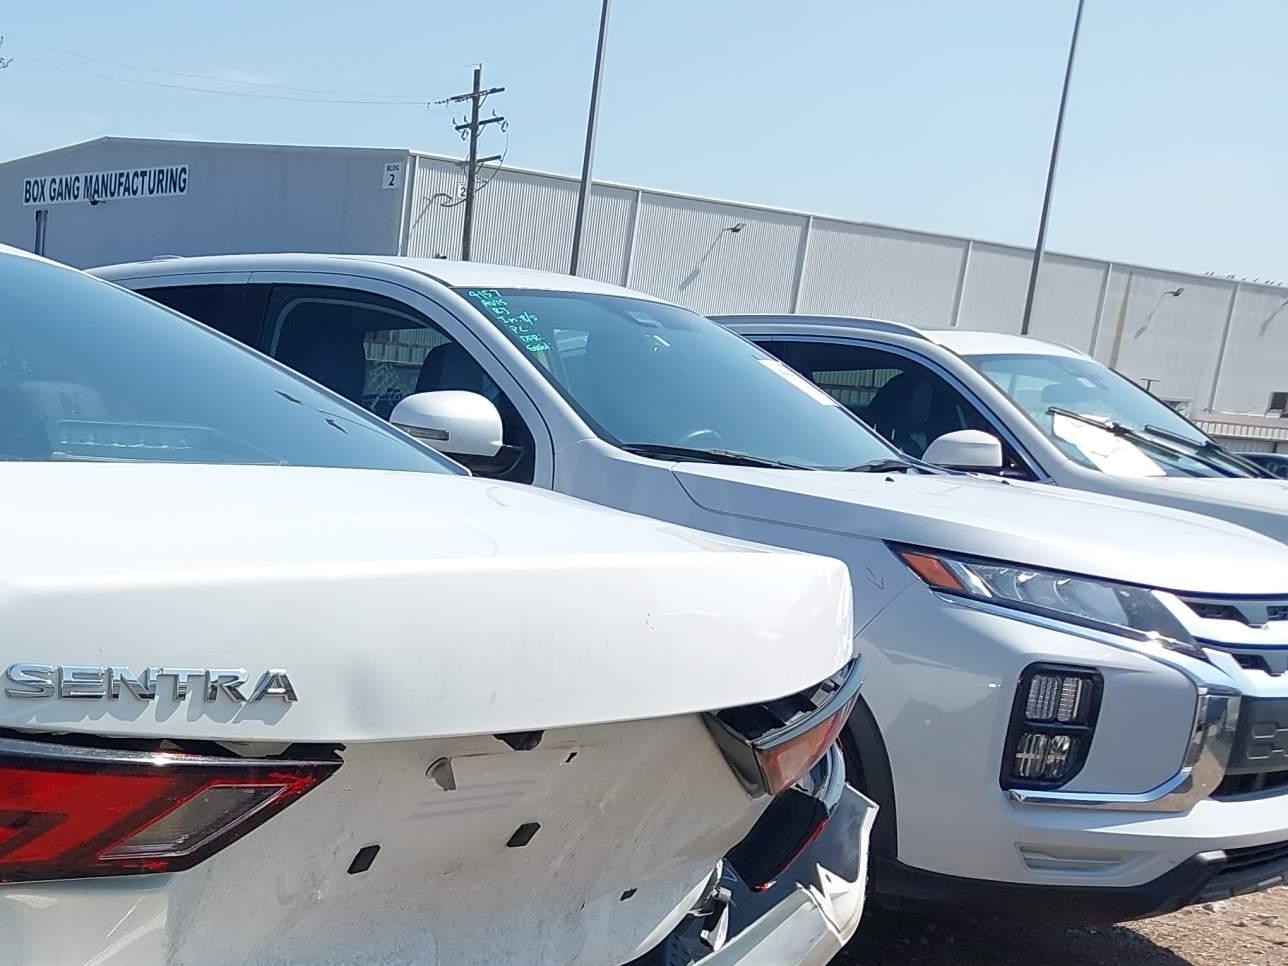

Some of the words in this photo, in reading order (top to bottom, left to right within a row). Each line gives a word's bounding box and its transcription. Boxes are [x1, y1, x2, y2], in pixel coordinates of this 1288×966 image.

[23, 177, 47, 203] BOX
[48, 174, 80, 202] GANG
[83, 166, 188, 200] MANUFACTURING
[388, 173, 395, 186] 2
[4, 662, 298, 702] SENTRA
